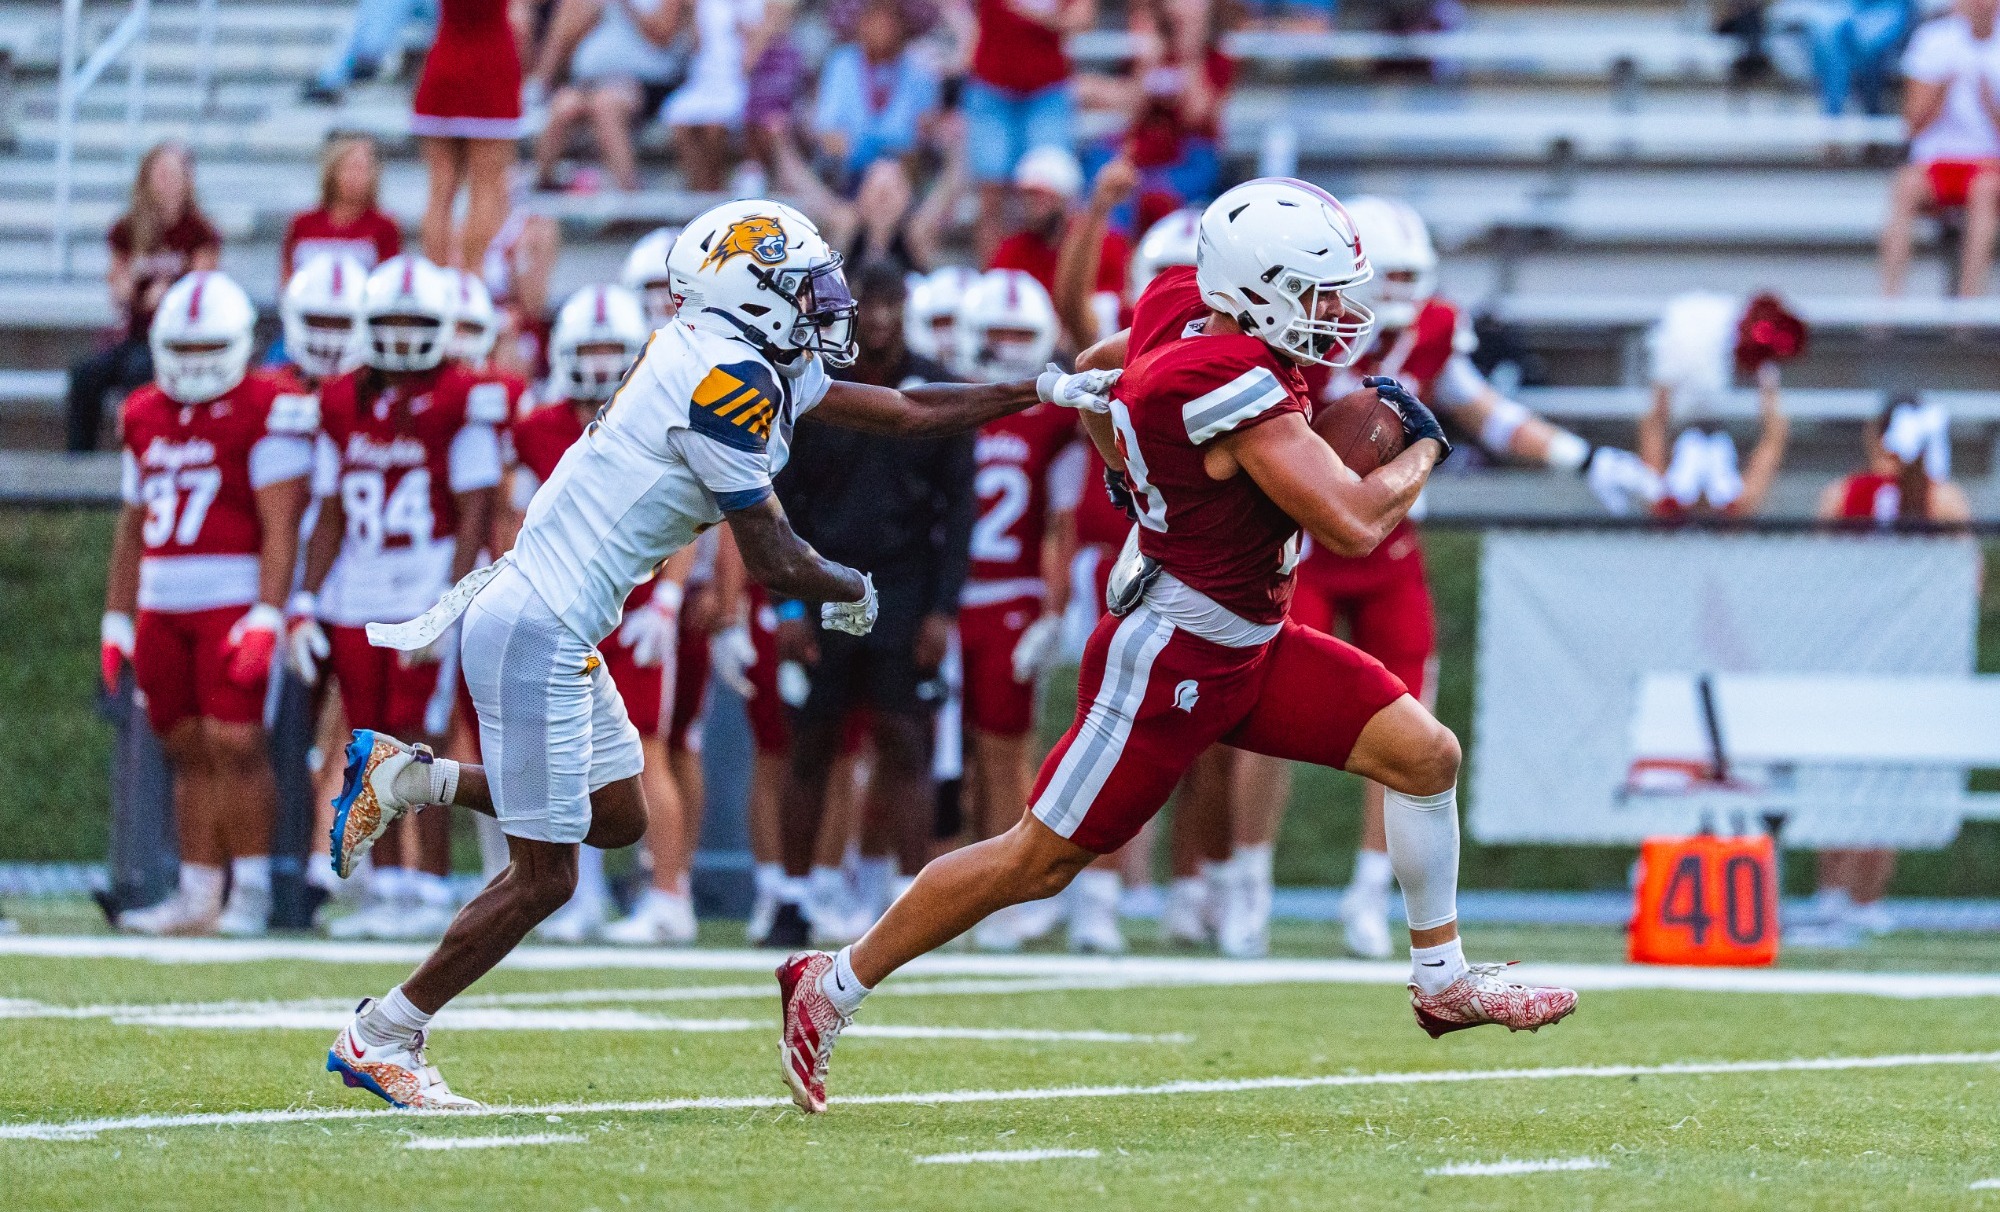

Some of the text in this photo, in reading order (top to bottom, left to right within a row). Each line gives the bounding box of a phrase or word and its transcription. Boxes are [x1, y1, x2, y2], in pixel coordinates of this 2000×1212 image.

[143, 467, 222, 547] 97
[342, 469, 435, 552] 84
[970, 465, 1032, 562] 2
[1662, 856, 1765, 945] 40
